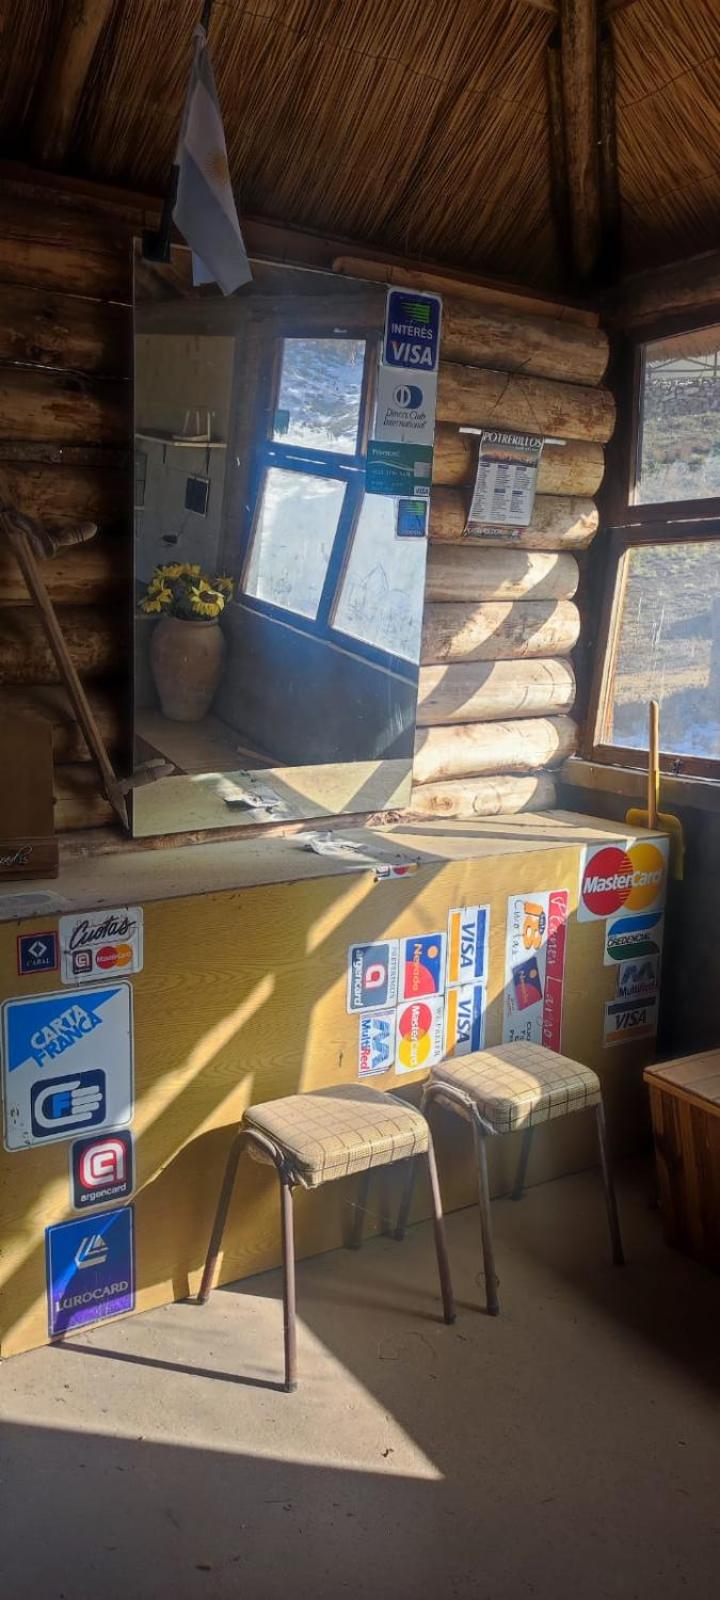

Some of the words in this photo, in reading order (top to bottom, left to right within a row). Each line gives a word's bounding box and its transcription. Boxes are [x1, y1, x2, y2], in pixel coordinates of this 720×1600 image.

[391, 340, 433, 366] VISA
[482, 431, 541, 448] POTRERILLOS
[583, 870, 662, 894] MasterCard
[69, 915, 136, 950] Cuotas
[460, 922, 475, 968] VISA
[26, 958, 50, 969] CABAL
[353, 950, 364, 1006] argencard
[31, 1004, 88, 1049] CARTA
[457, 999, 471, 1043] VISA
[615, 1011, 647, 1029] VISA
[32, 1011, 103, 1067] FRANCA
[360, 1019, 371, 1072] MultiRed
[80, 1183, 127, 1202] argencard
